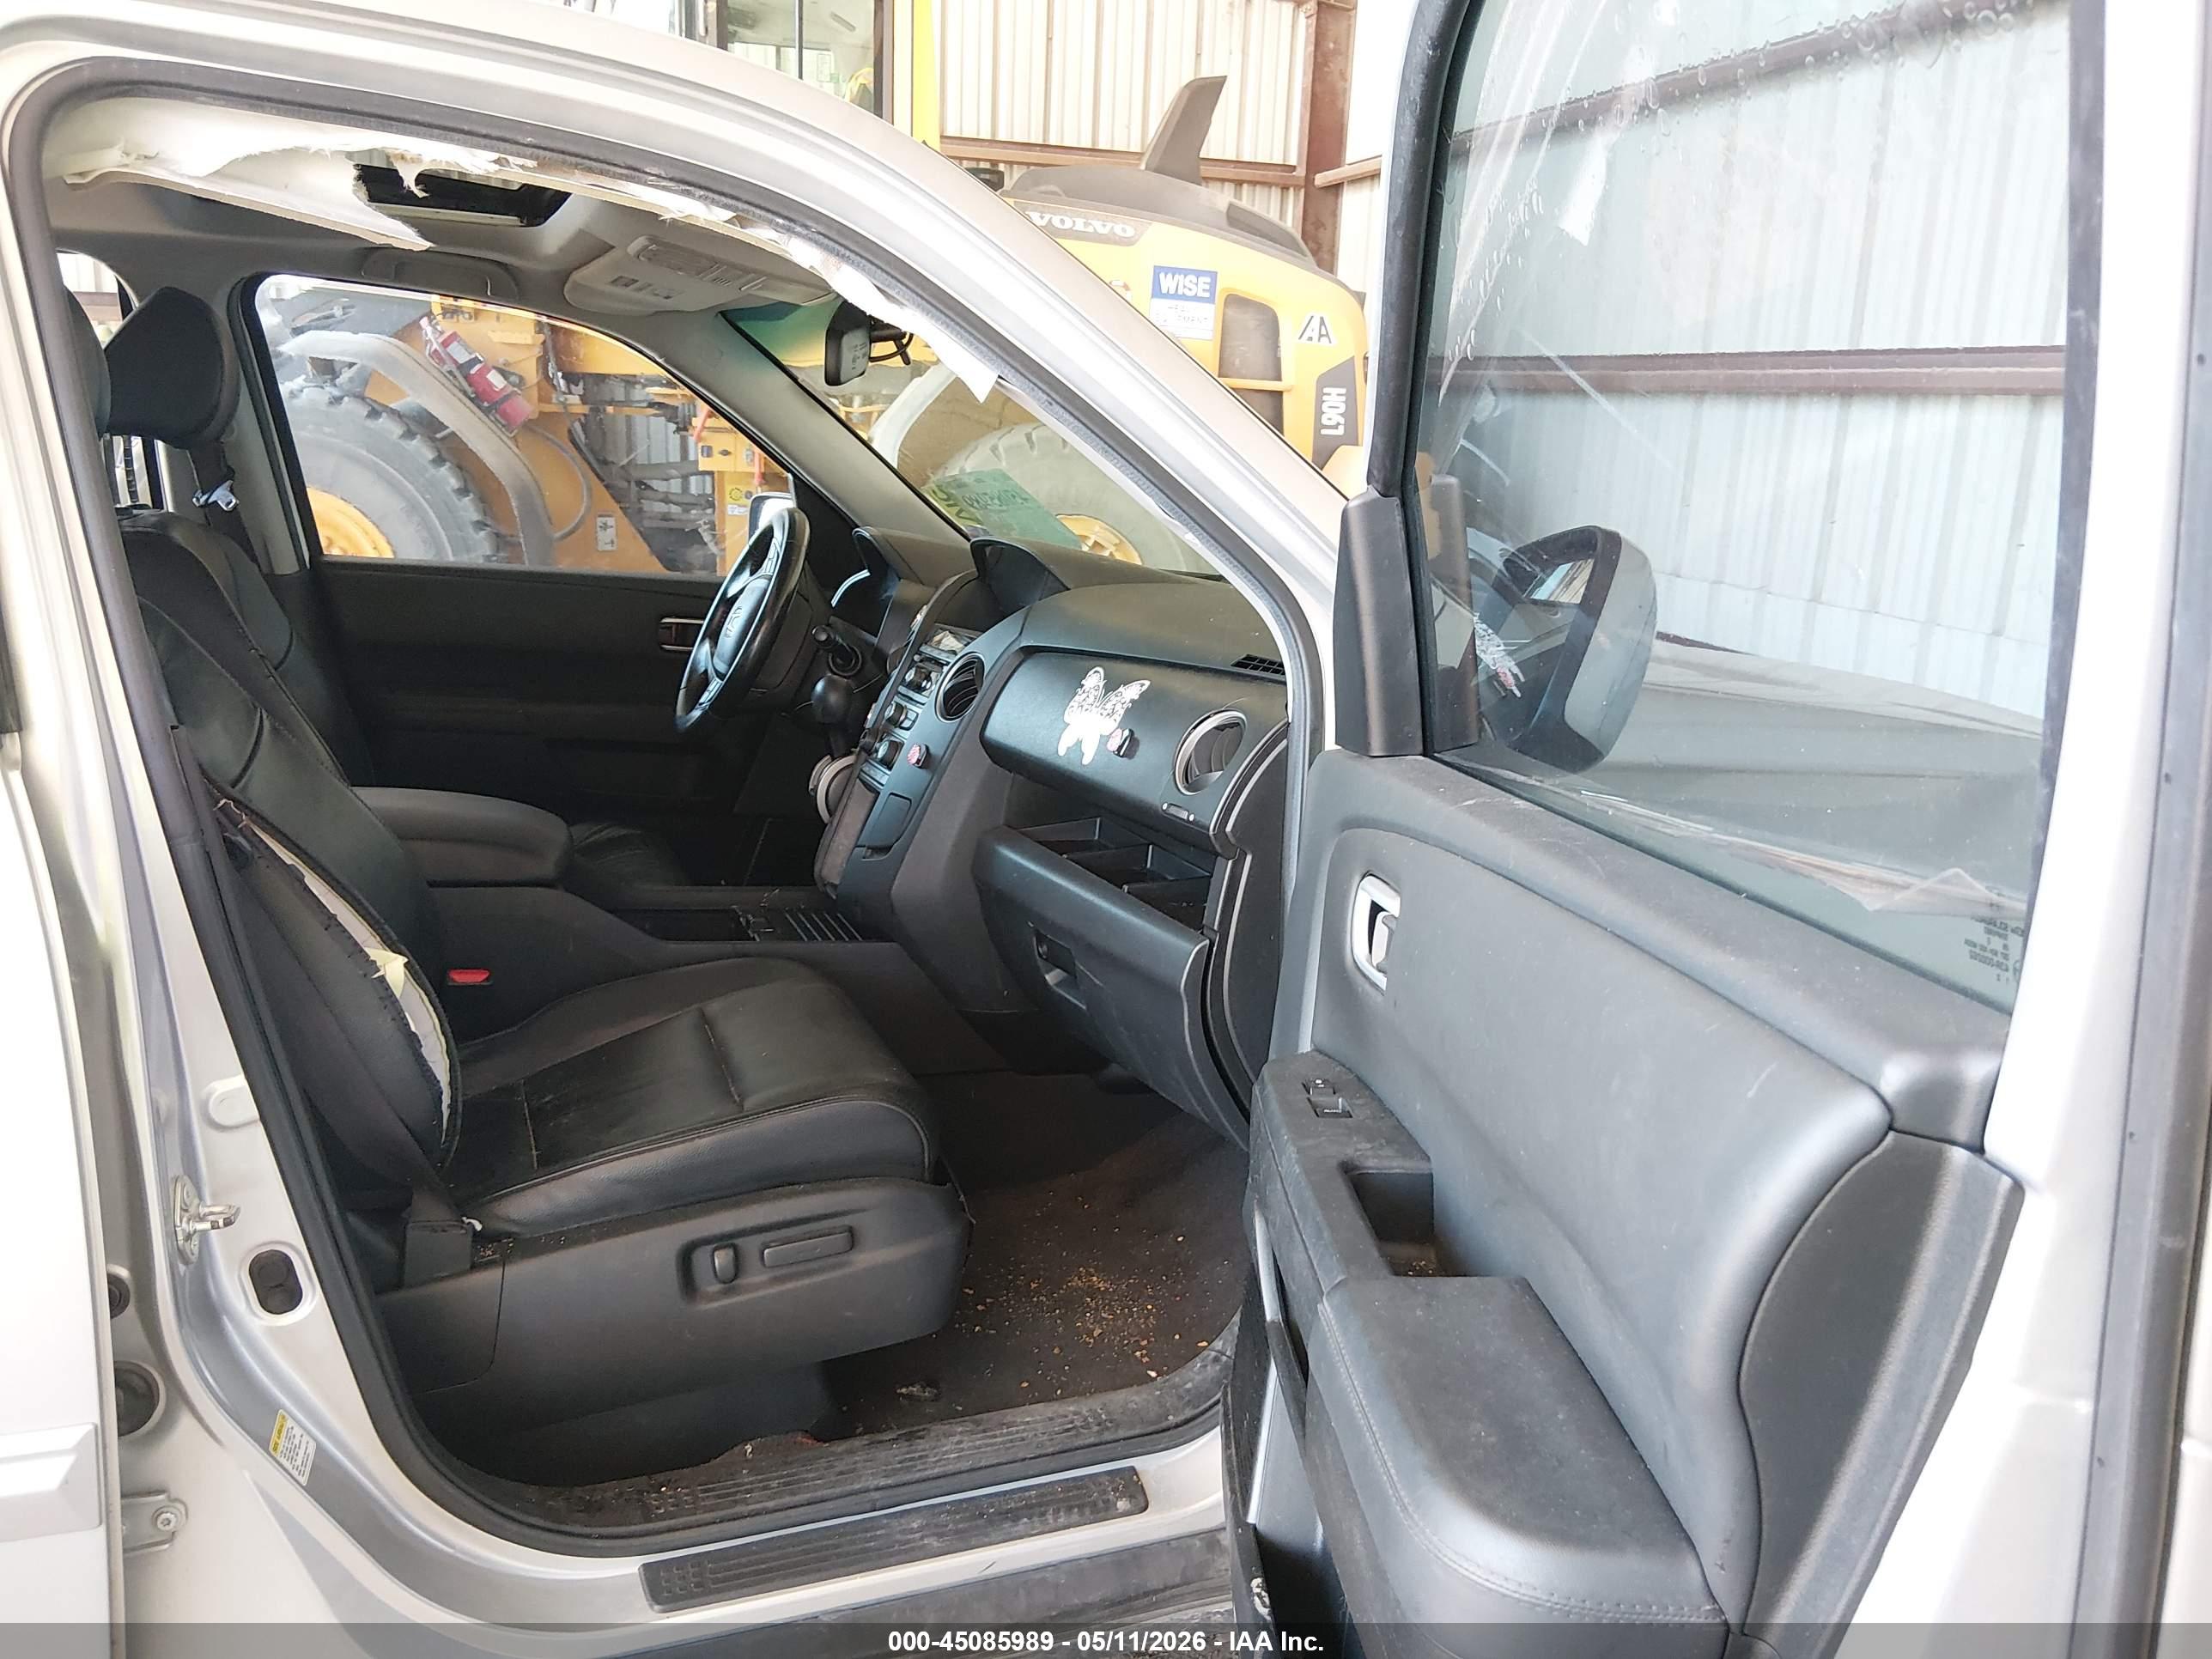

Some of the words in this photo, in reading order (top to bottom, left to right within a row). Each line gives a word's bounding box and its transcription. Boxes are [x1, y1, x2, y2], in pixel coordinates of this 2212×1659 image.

[1024, 211, 1135, 238] VOLVO
[1158, 271, 1211, 298] WISE
[1320, 386, 1347, 435] L90H
